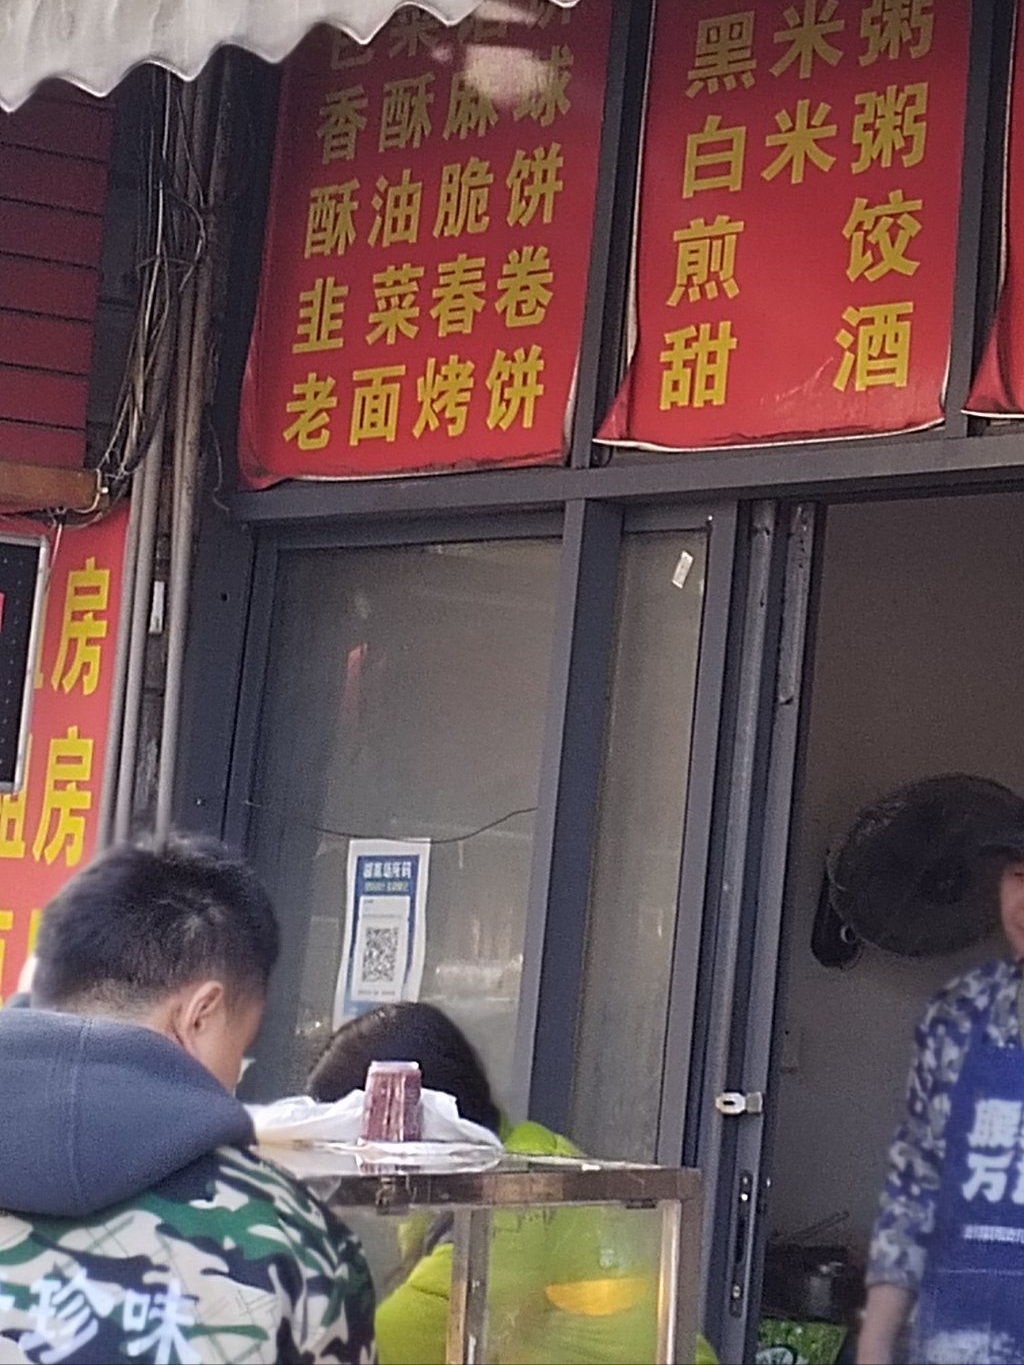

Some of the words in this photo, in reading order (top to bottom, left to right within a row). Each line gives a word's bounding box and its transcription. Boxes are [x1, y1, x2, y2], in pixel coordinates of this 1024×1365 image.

[680, 80, 930, 199] 白米粥
[303, 140, 566, 260] 酥油脆饼
[666, 188, 925, 308] 煎饺
[292, 243, 556, 355] 韭菜春卷
[658, 300, 915, 411] 甜酒
[282, 343, 546, 452] 老面烤饼
[35, 557, 111, 696] 房
[0, 1267, 202, 1365] 珍味
